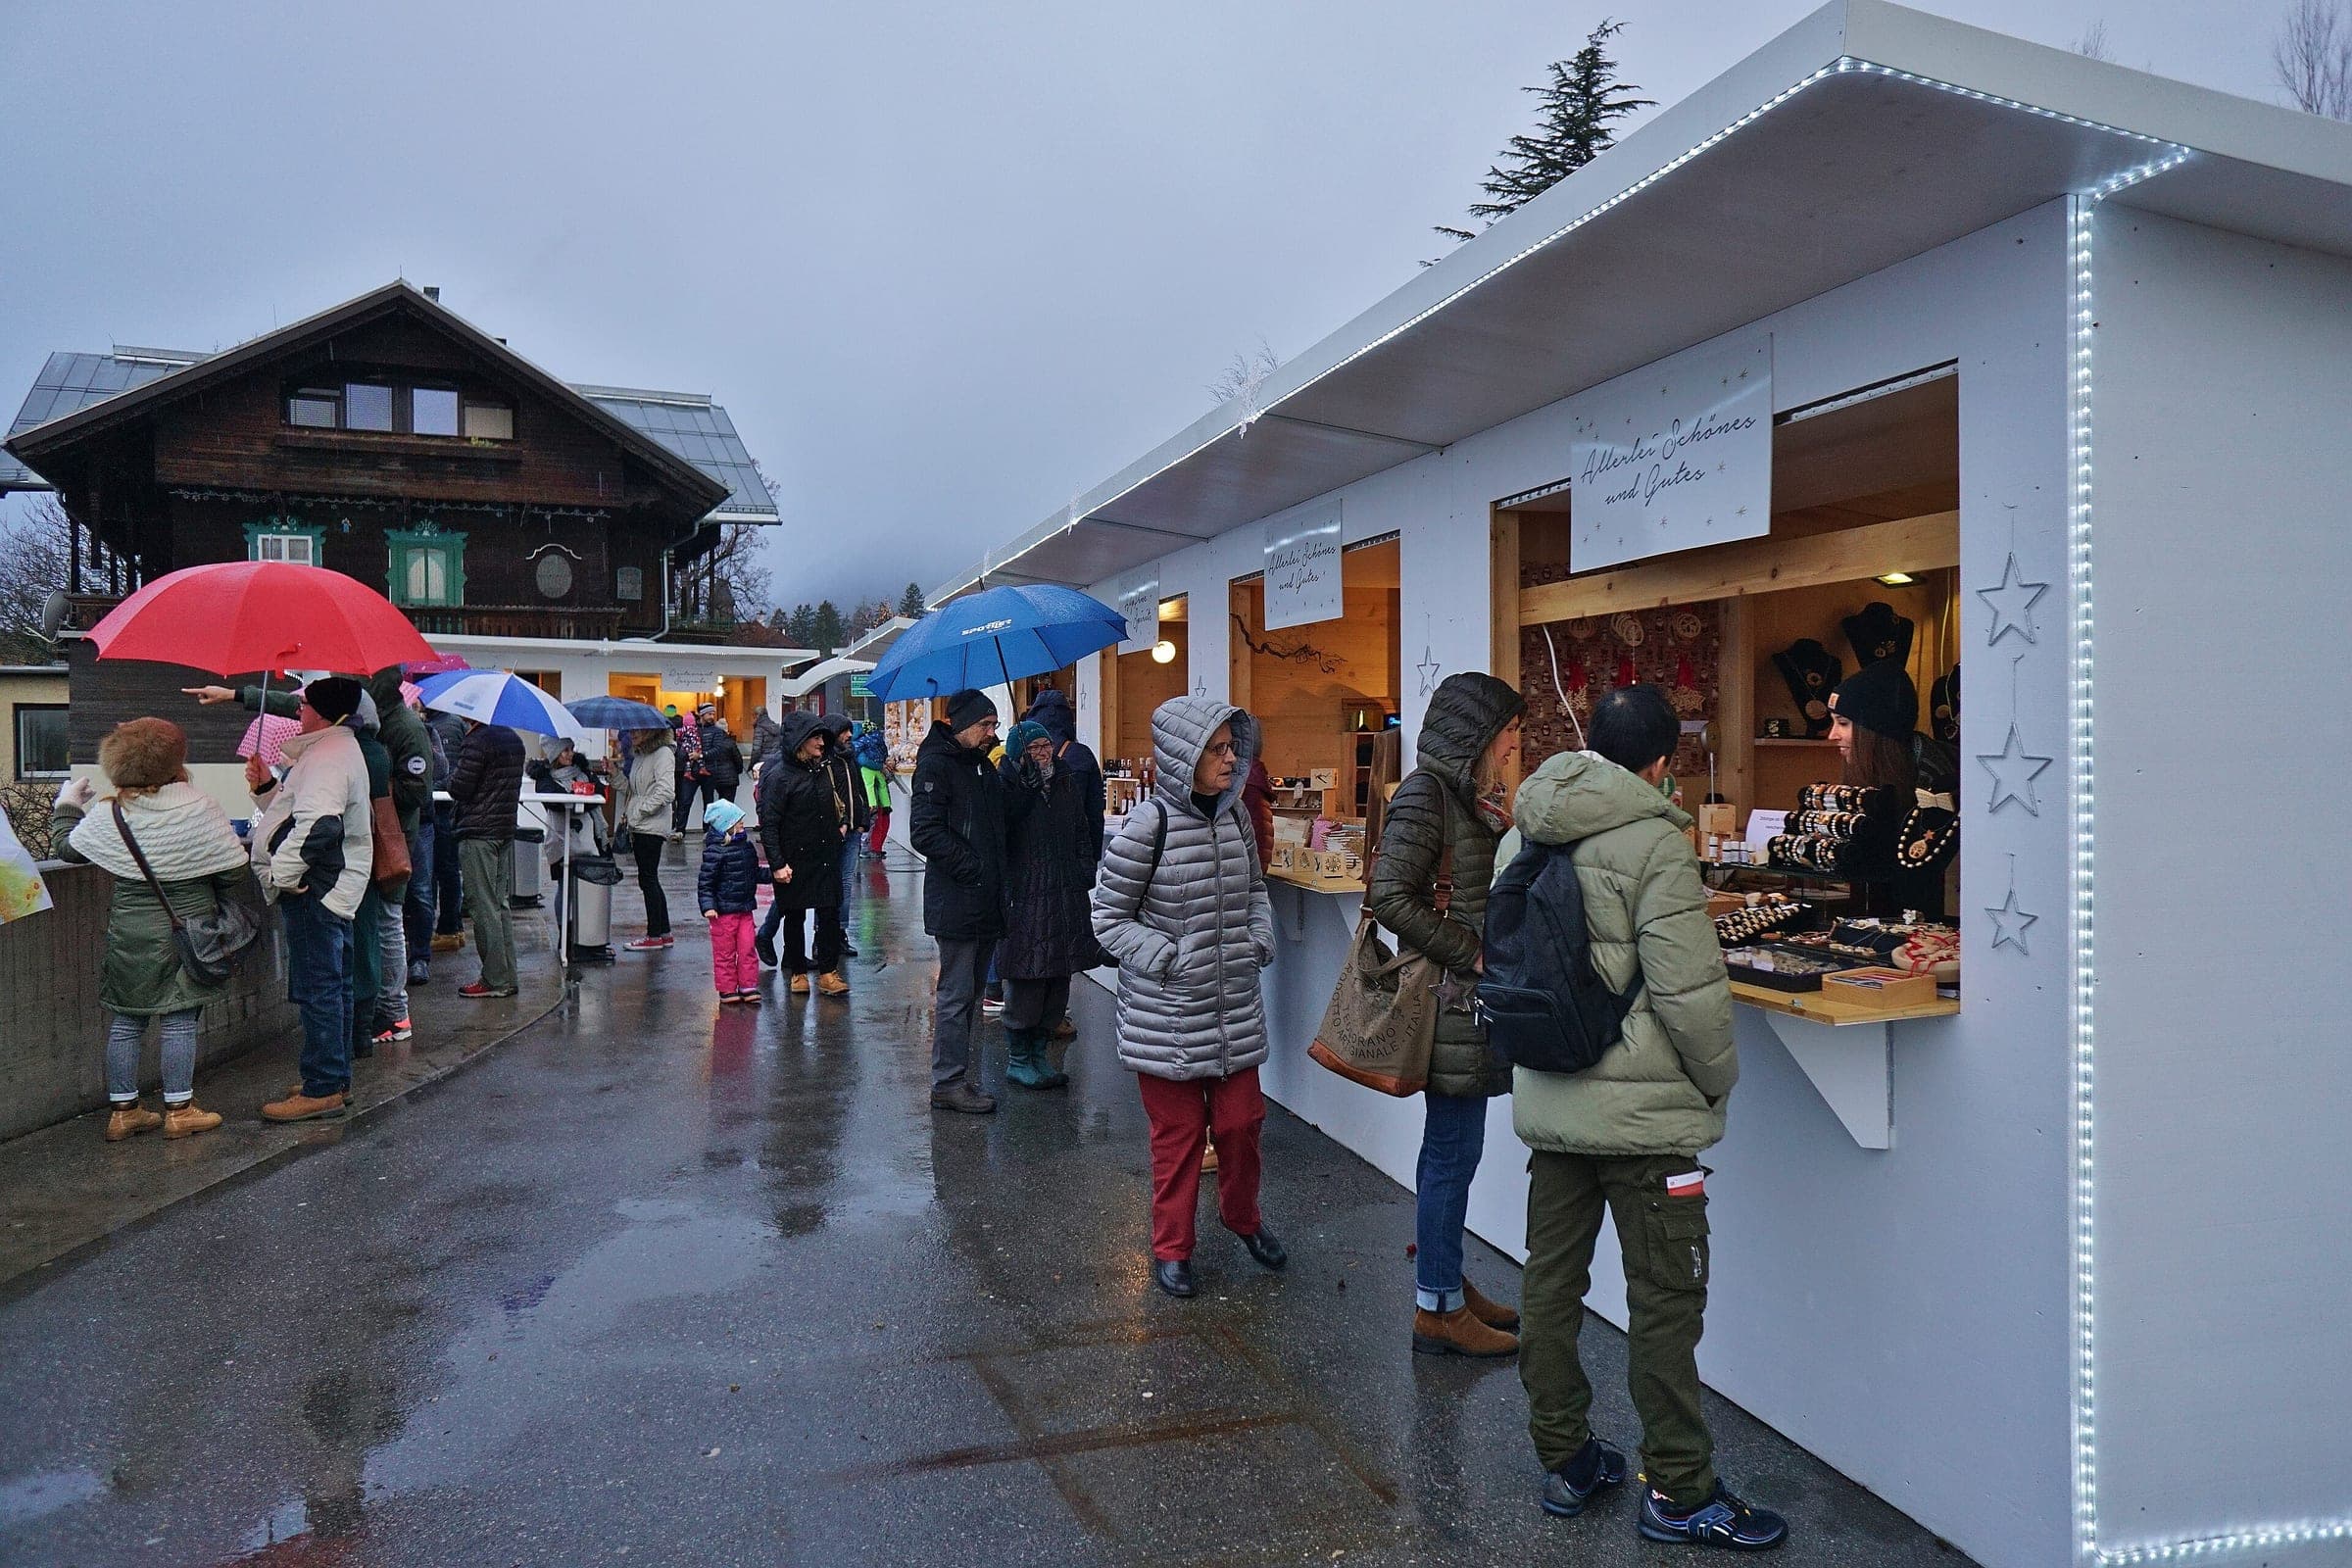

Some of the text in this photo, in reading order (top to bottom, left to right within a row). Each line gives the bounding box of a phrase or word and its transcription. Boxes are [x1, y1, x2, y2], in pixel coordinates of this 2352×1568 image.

[1581, 414, 1756, 484] Allerlei Schönes
[1605, 461, 1706, 507] und Gutes
[1268, 542, 1337, 576] Allerlei Schönes
[1279, 567, 1319, 595] und Gutes
[1404, 993, 1422, 1038] ITALIA
